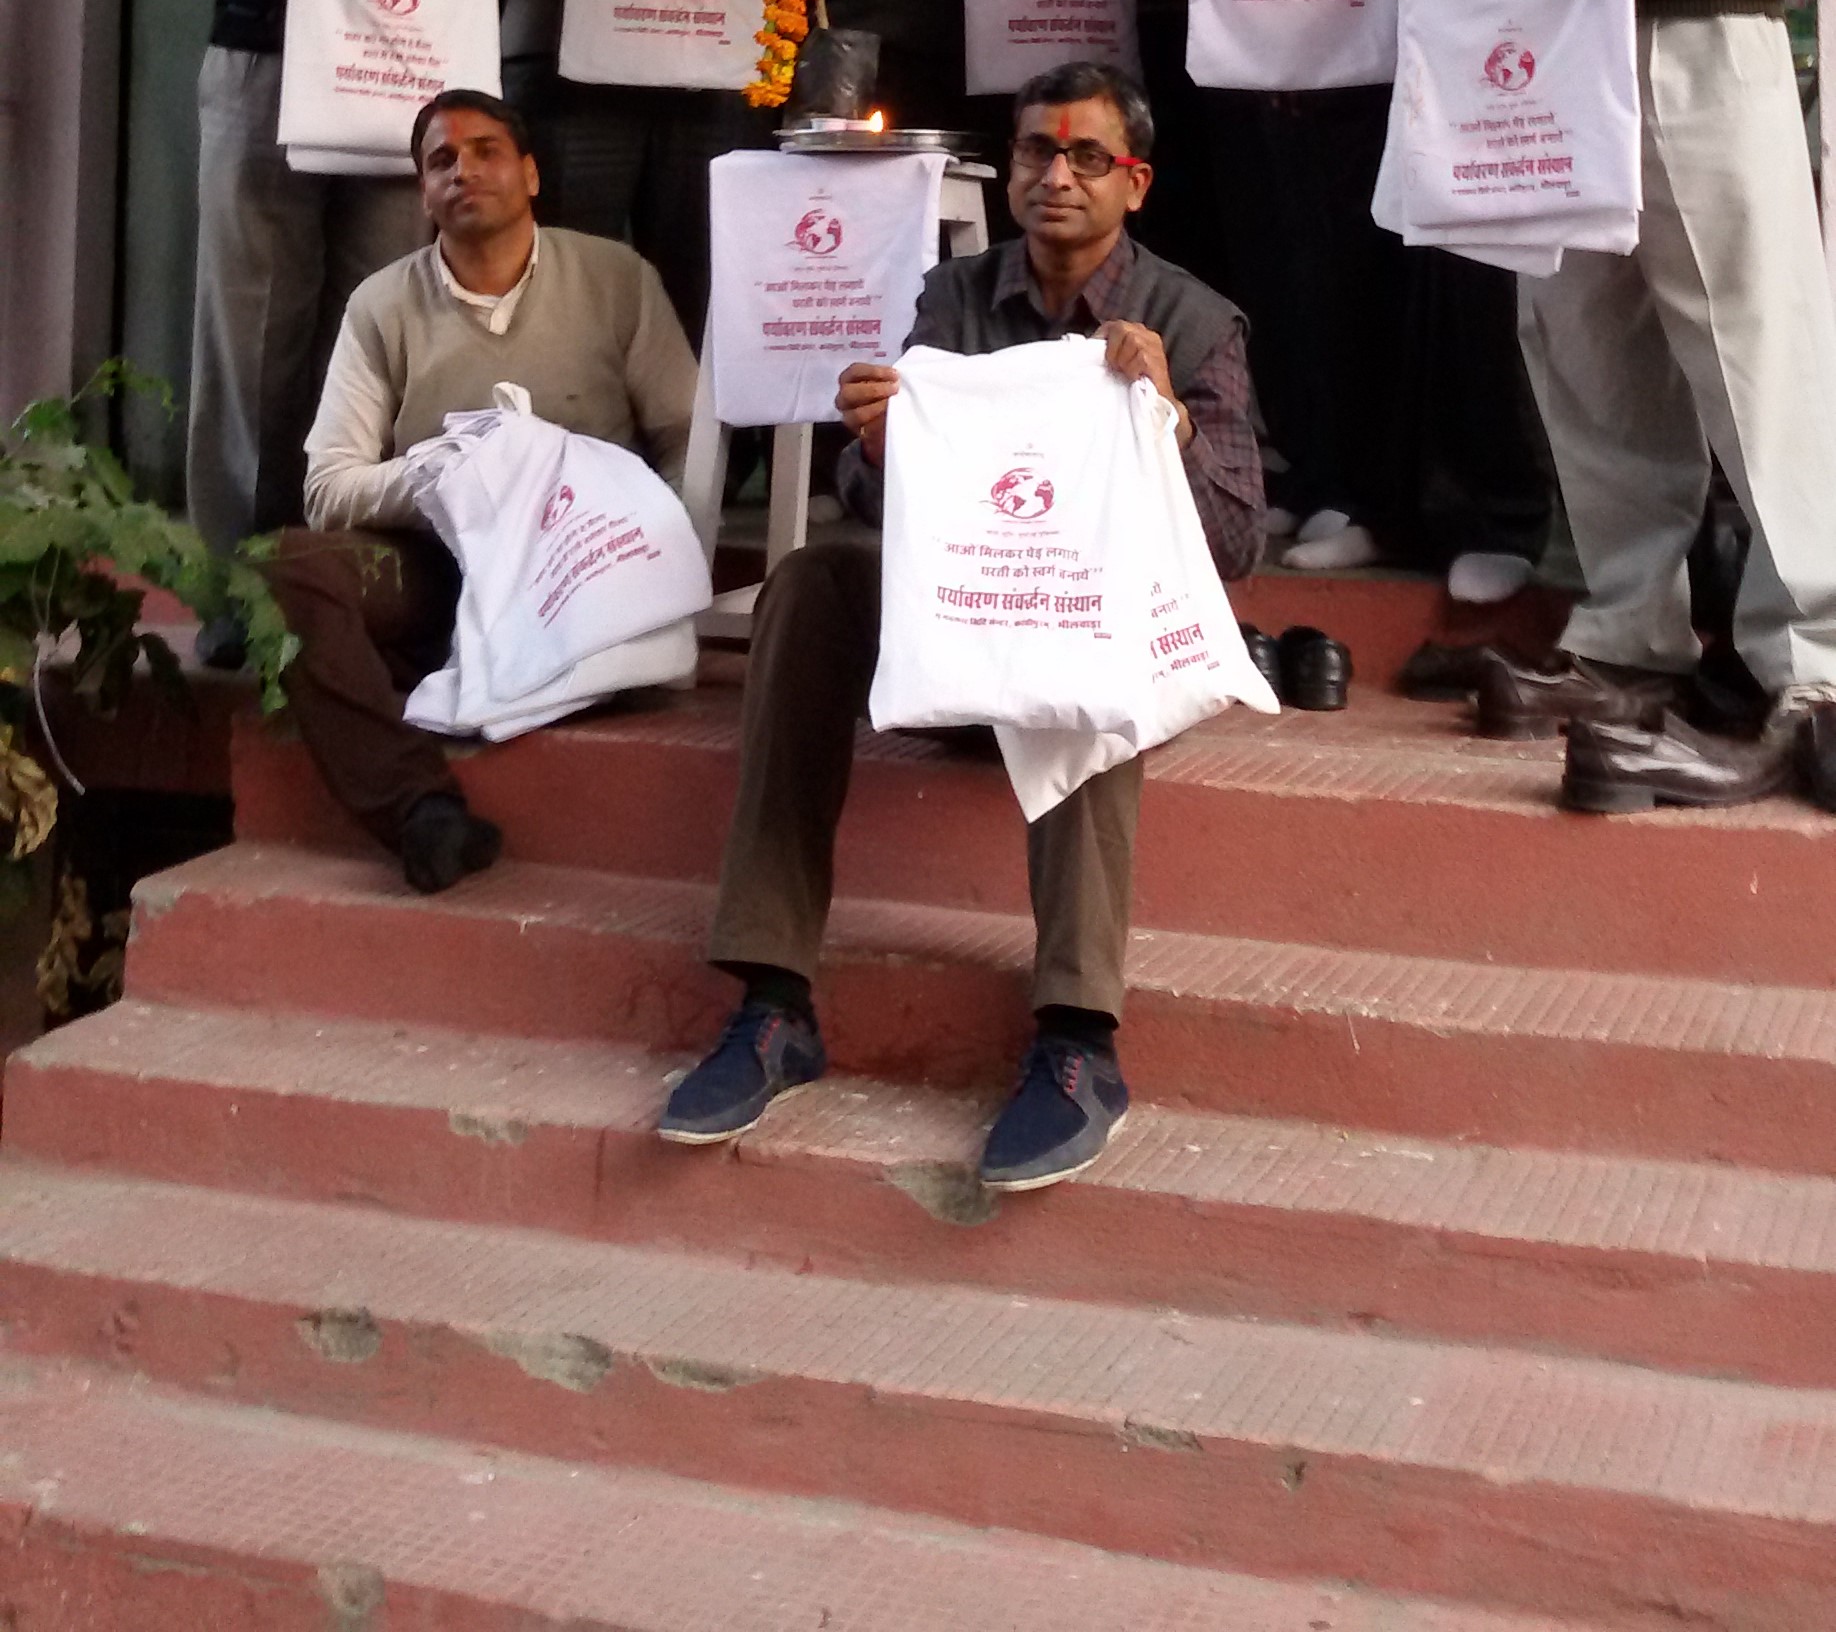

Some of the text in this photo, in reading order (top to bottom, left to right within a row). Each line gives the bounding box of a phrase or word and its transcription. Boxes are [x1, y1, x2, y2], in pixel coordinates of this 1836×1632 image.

[1013, 564, 1030, 578] को
[936, 584, 999, 610] पर्यावरण
[1054, 590, 1103, 613] संस्थान
